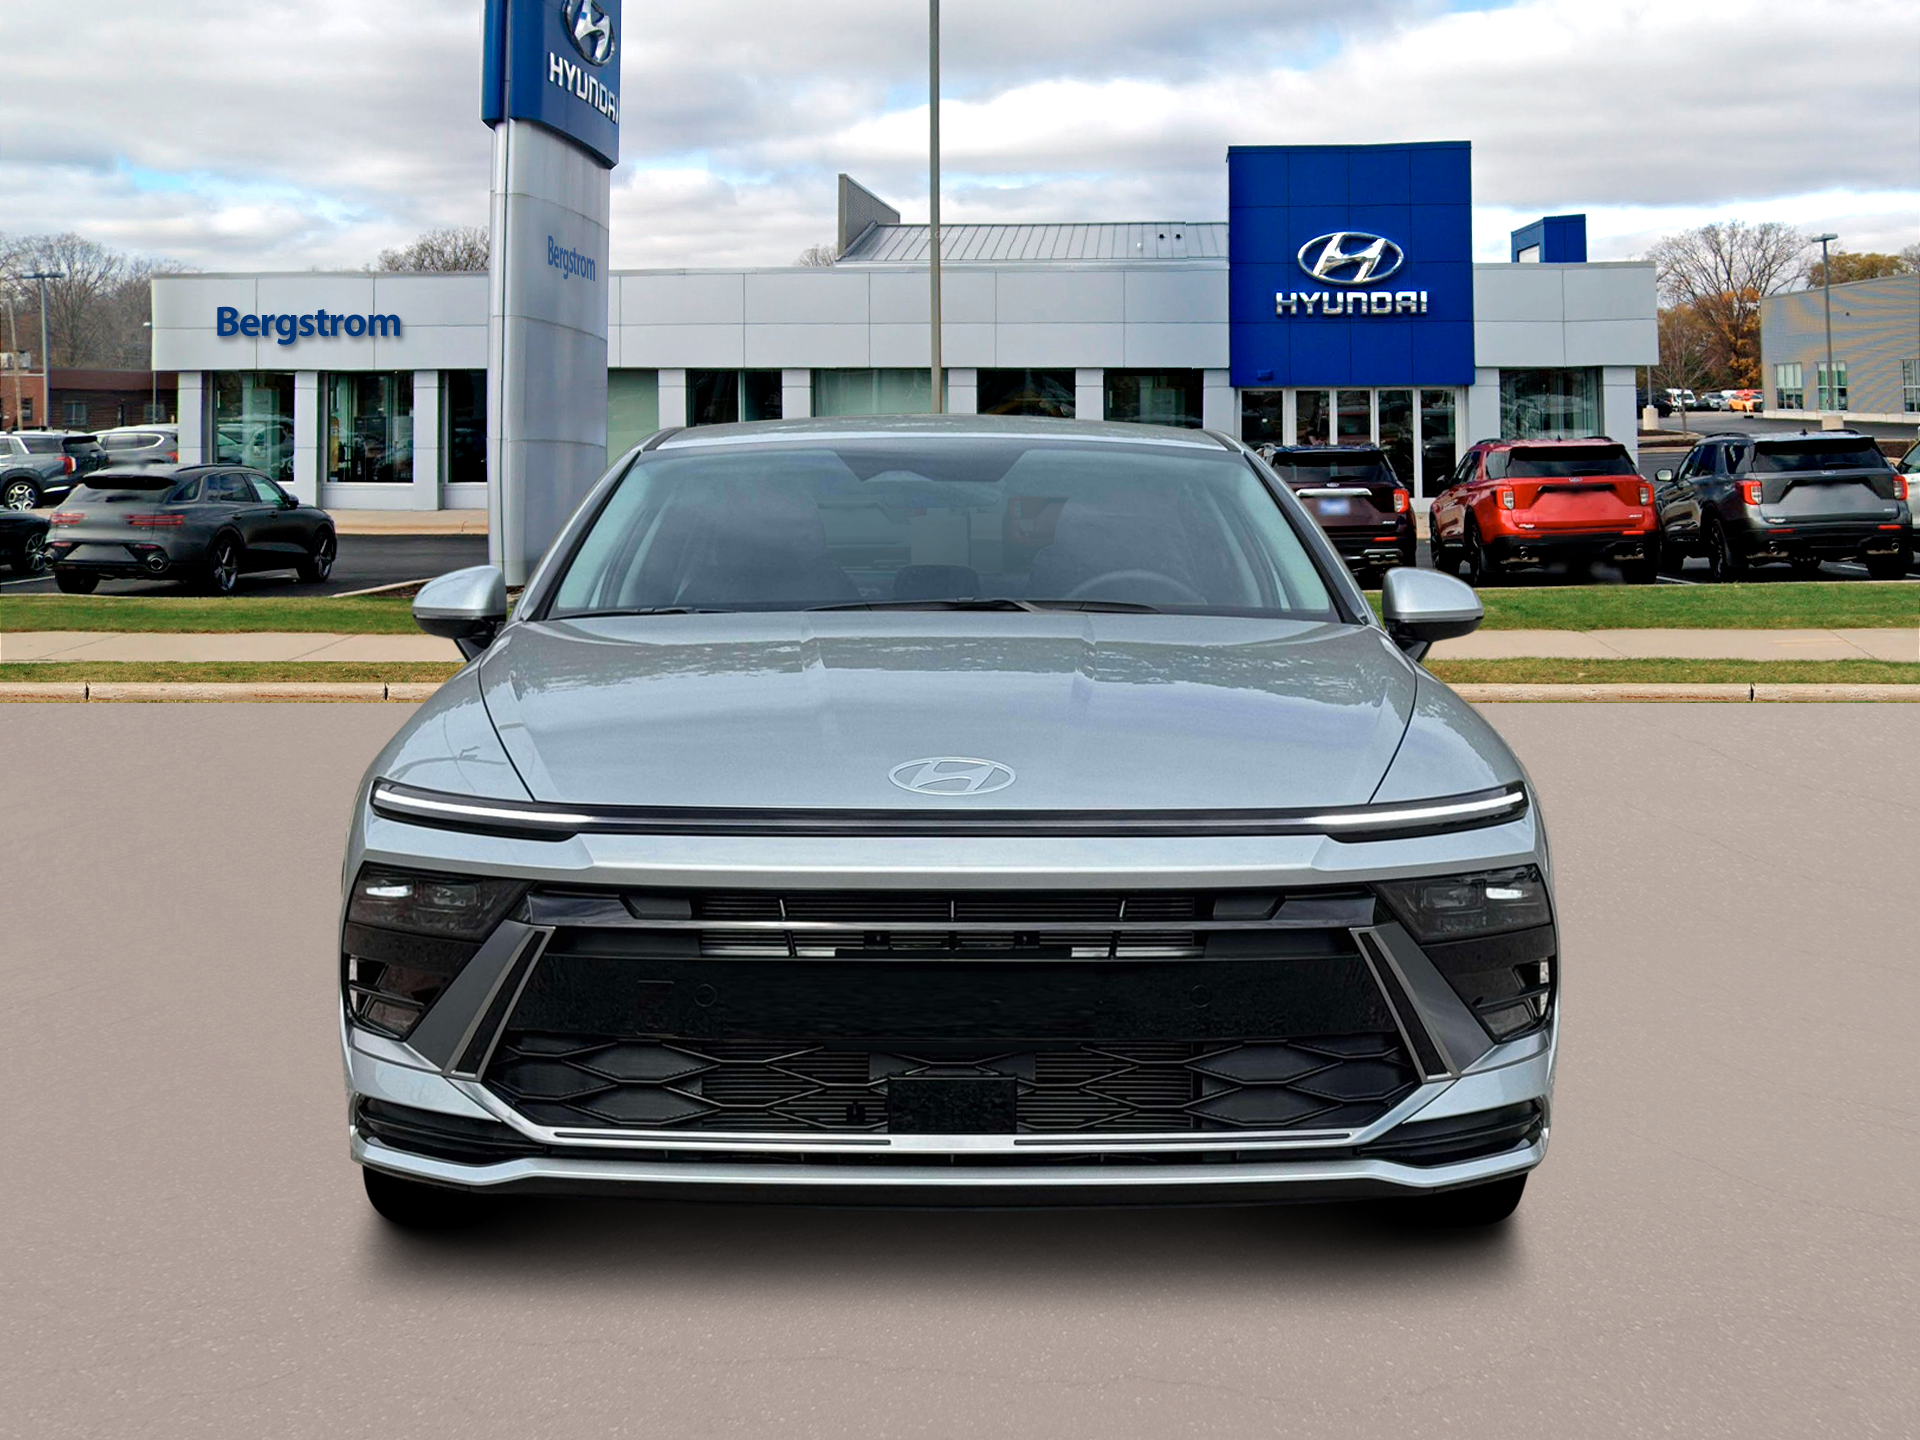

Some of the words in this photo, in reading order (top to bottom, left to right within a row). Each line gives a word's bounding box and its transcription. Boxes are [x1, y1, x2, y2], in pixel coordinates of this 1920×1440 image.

[549, 51, 619, 124] HYUNDAI
[548, 235, 595, 282] Bergstrom
[1276, 291, 1428, 316] HYUNDAI
[217, 306, 401, 346] Bergstrom
